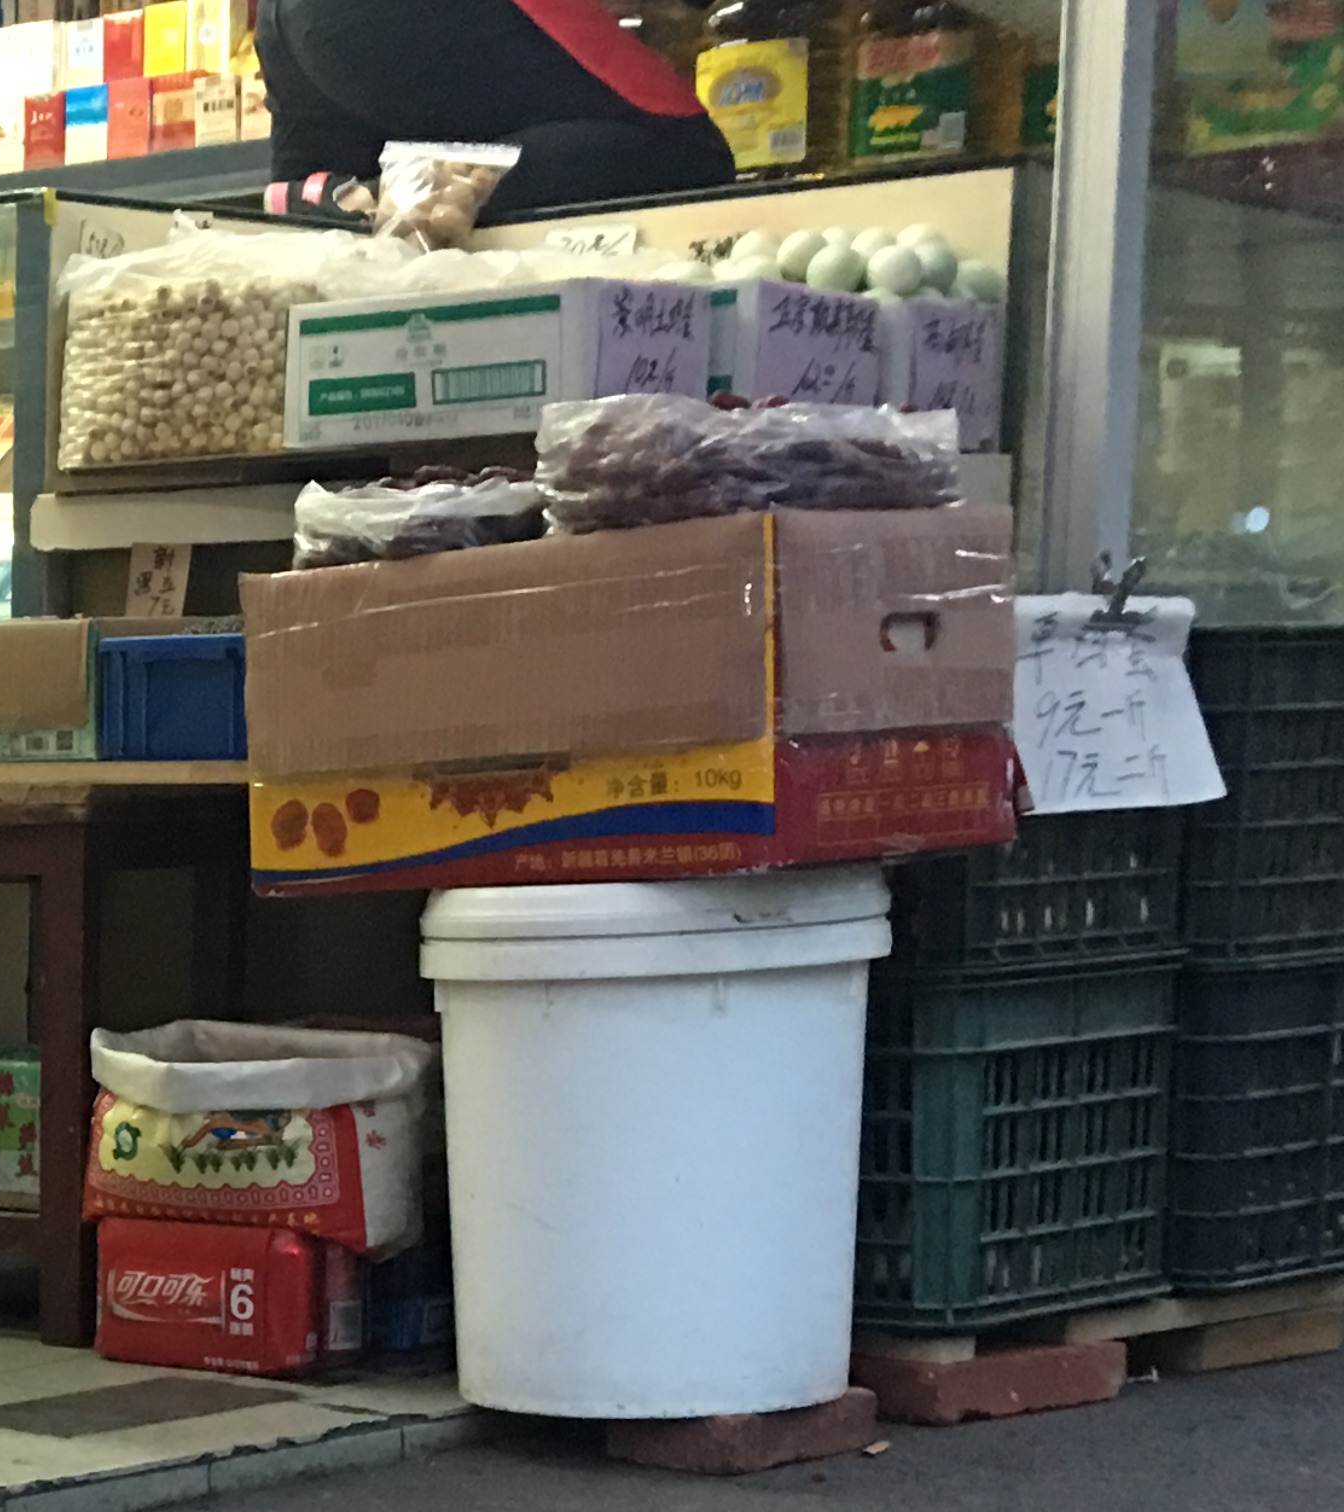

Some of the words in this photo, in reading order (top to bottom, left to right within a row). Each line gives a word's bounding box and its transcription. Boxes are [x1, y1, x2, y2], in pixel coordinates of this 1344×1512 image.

[1035, 689, 1146, 749] 9元一斤
[117, 1270, 215, 1306] 可口可乐
[230, 1283, 254, 1320] 6
